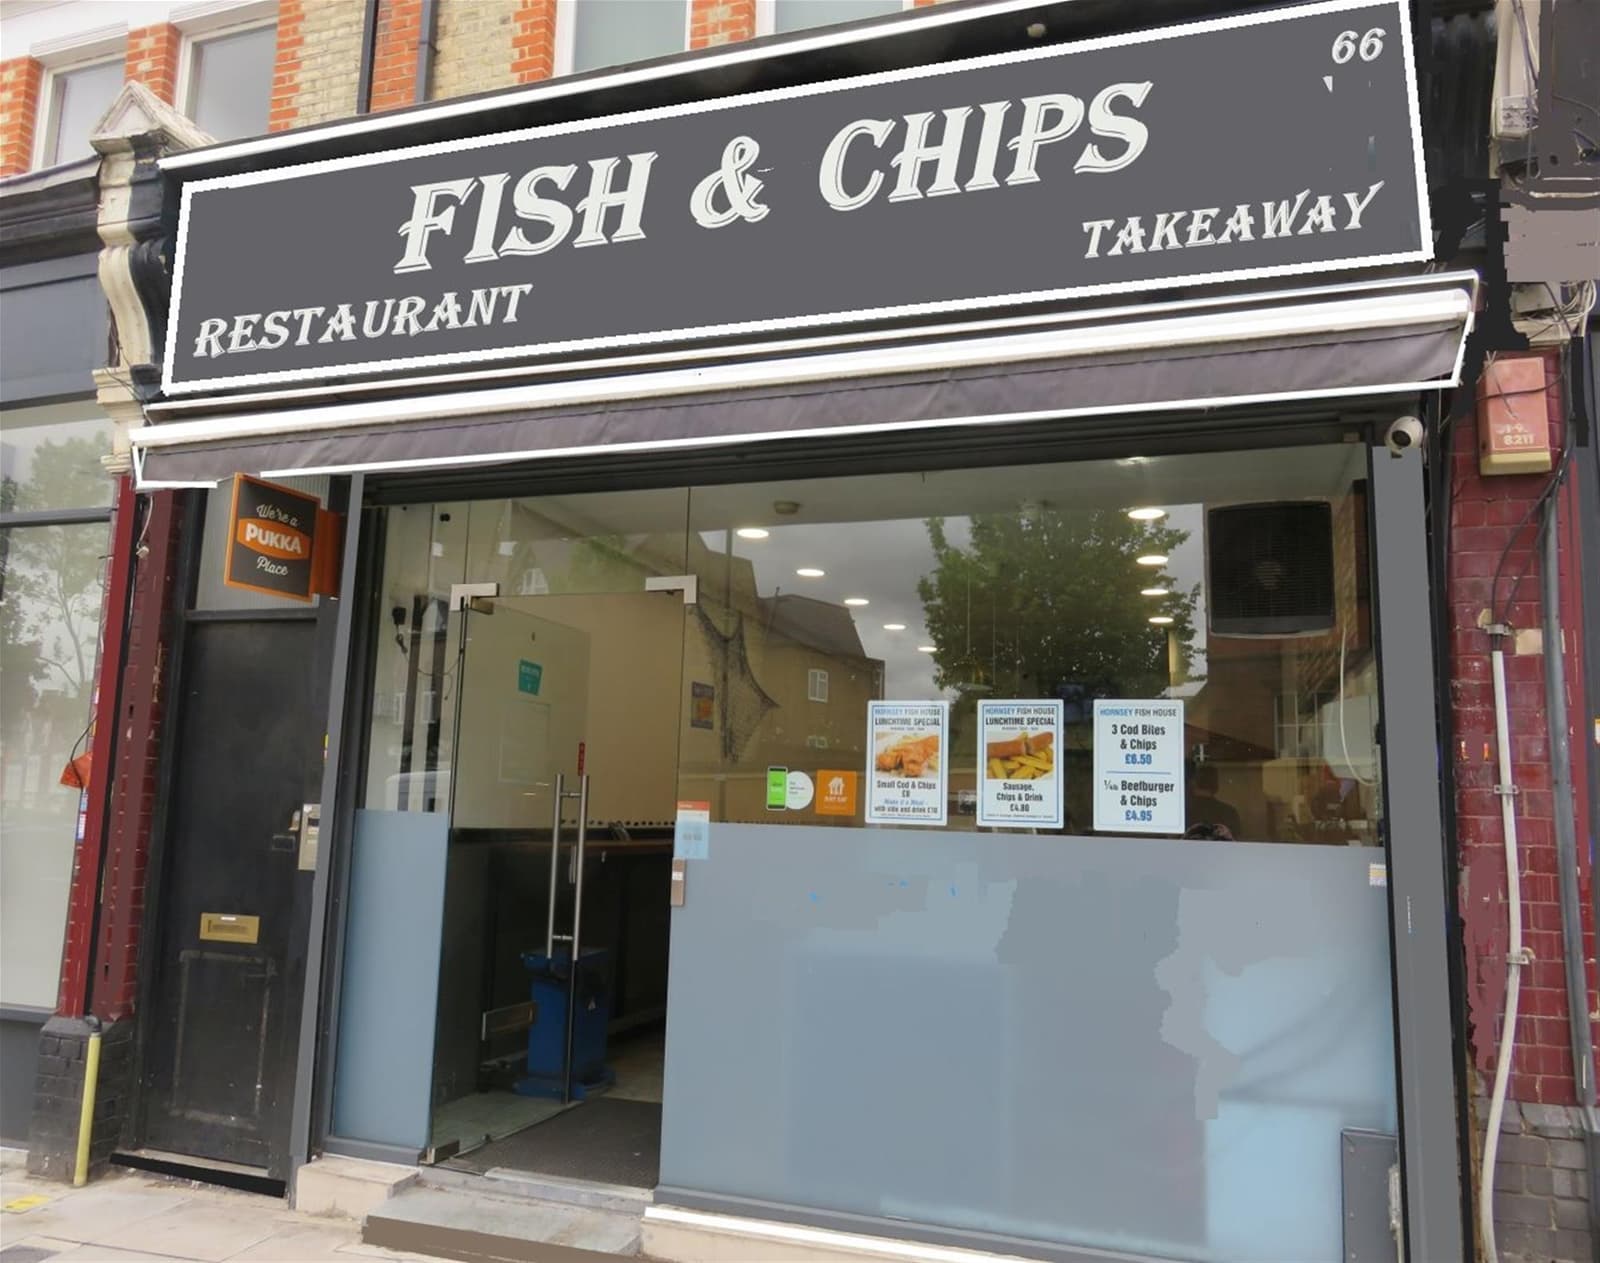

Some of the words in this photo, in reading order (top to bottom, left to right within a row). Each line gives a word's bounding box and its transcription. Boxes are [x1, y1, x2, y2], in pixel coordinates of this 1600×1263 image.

[1331, 27, 1387, 65] 66
[393, 151, 659, 274] FISH
[689, 135, 771, 229] &
[818, 80, 1154, 212] CHIPS
[1082, 180, 1386, 259] TAKEAWAY
[193, 284, 533, 360] RESTAURANT
[256, 503, 289, 521] We're
[289, 517, 299, 527] a
[245, 522, 302, 554] PUKKA
[256, 555, 289, 576] Place
[1016, 707, 1031, 715] FISH
[1033, 707, 1055, 715] HOUSE
[1100, 708, 1133, 717] HORNSEY
[1134, 708, 1151, 717] FISH
[1152, 708, 1177, 717] HOUSE
[875, 717, 912, 726] LUNCHTIME
[913, 717, 940, 726] SPECIAL
[985, 716, 1025, 725] LUNCHTIME
[1026, 716, 1055, 726] SPECIAL
[1111, 724, 1118, 735] 3
[1120, 724, 1139, 735] Cod
[1141, 724, 1166, 736] Bites
[1120, 739, 1127, 750] &
[1130, 739, 1157, 751] Chips
[877, 780, 896, 789] Small
[896, 780, 910, 789] Cod
[917, 781, 936, 790] Chips
[1121, 780, 1175, 793] Beefburger
[996, 793, 1016, 802] Chips
[1017, 792, 1023, 801] &
[1024, 792, 1043, 801] Drink
[1120, 795, 1127, 806] &
[1130, 795, 1157, 807] Chips
[1125, 809, 1153, 821] £4.95
